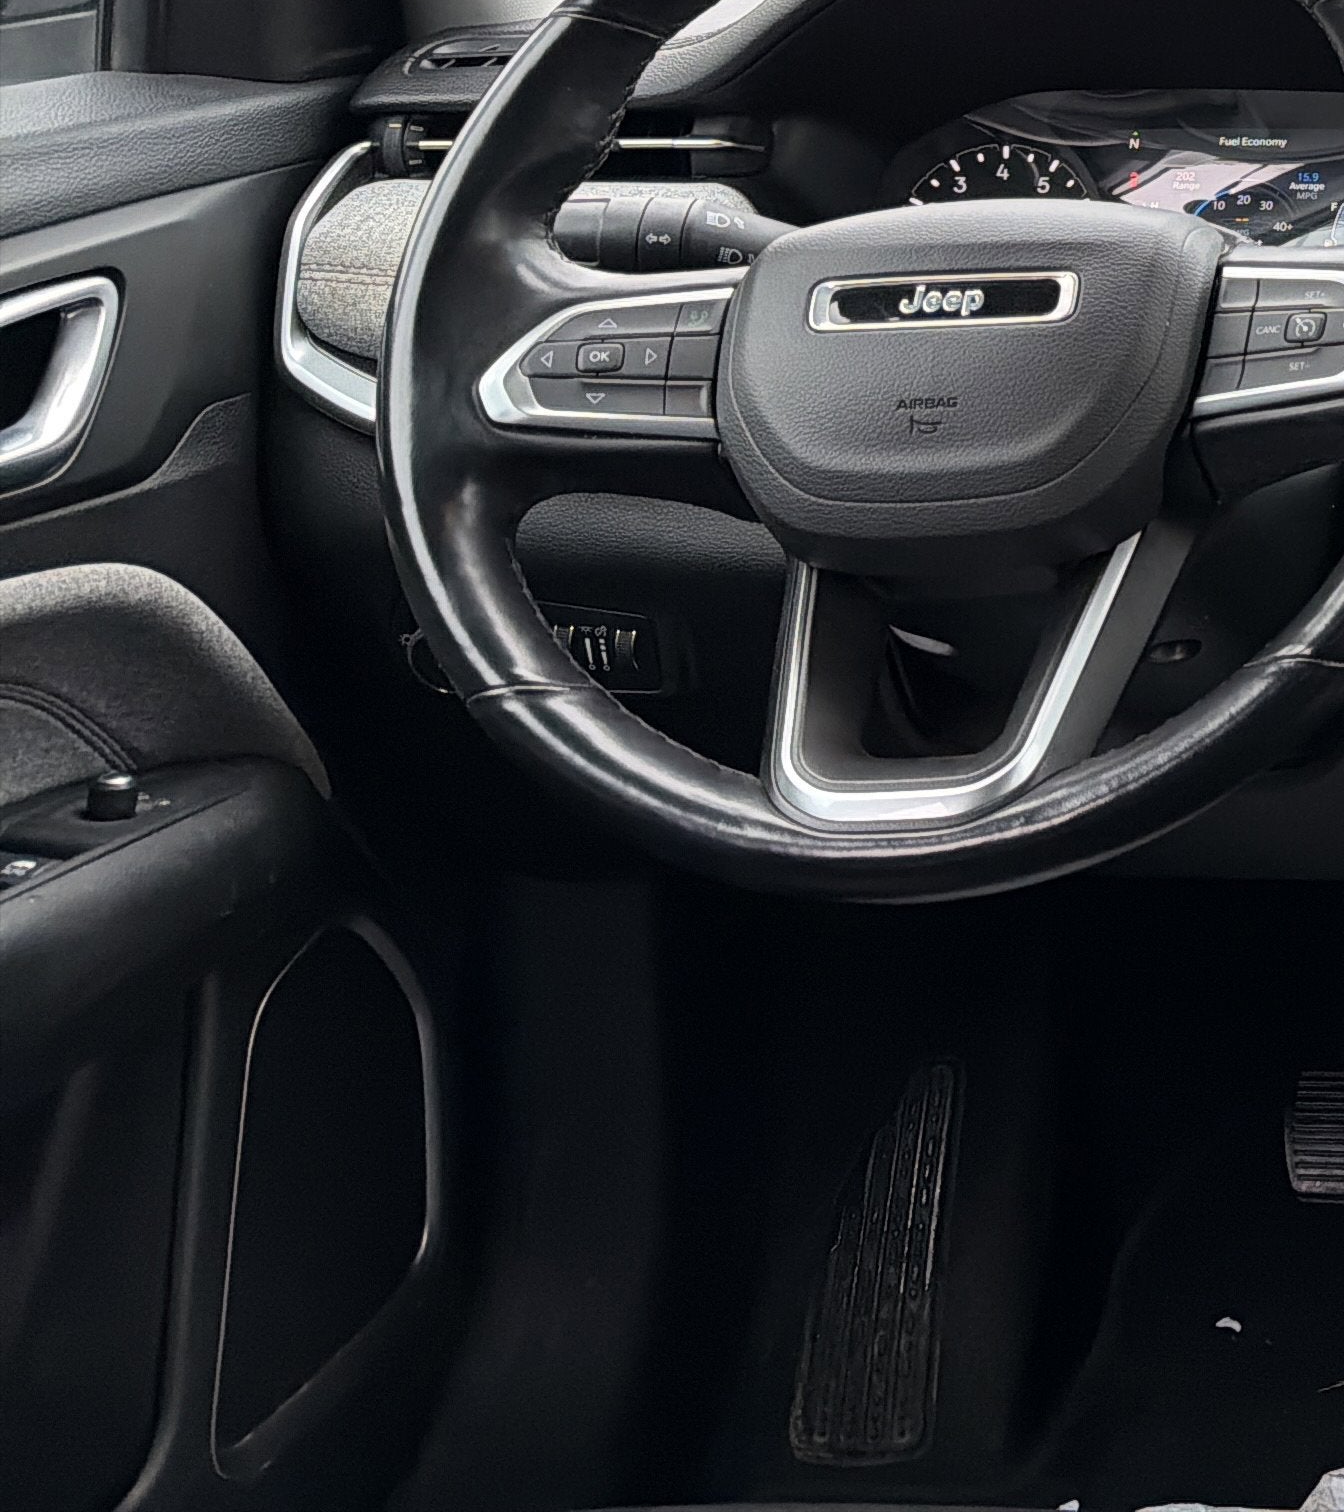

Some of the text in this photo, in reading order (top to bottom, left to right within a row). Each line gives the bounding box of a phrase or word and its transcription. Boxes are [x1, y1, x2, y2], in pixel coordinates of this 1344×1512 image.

[1128, 138, 1140, 150] N
[1218, 136, 1288, 149] Fuel Economy
[996, 164, 1010, 181] 4
[1175, 171, 1197, 182] 202
[1297, 172, 1319, 183] 15.9
[953, 176, 967, 194] 3
[1036, 176, 1050, 194] 5
[1172, 181, 1201, 192] Range
[1288, 181, 1325, 193] Average
[1236, 195, 1252, 206] 20
[1296, 191, 1318, 201] MPG
[1212, 200, 1226, 211] 10
[1259, 200, 1274, 211] 30
[1330, 202, 1339, 212] F
[1272, 221, 1294, 232] 40+
[898, 284, 985, 317] Jeep
[1255, 324, 1283, 335] CANC
[589, 350, 611, 363] OK
[896, 397, 958, 411] AIRBAG
